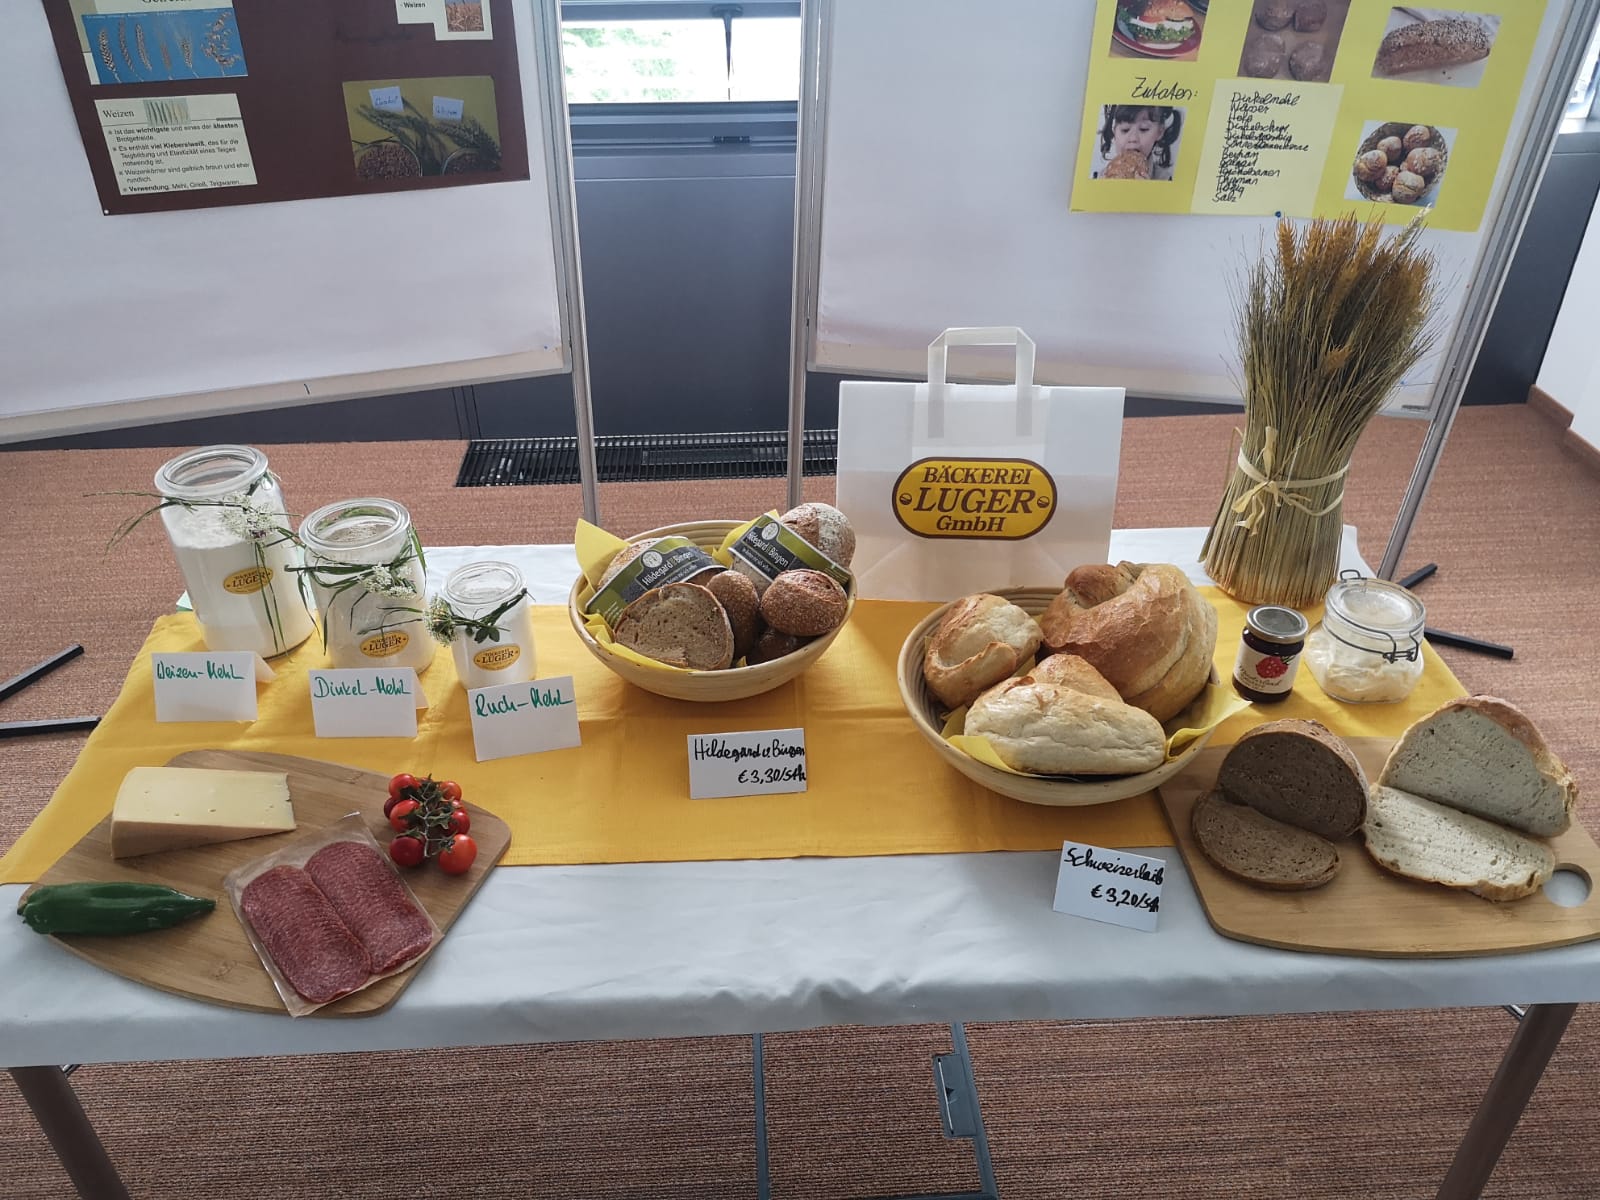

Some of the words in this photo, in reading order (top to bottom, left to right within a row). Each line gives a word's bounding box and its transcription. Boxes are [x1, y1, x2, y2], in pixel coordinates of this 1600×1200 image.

[1132, 77, 1198, 100] Zutaten:
[103, 110, 134, 118] Weizen
[922, 465, 1033, 485] BÄCKEREI
[912, 487, 1036, 514] LUGER
[936, 515, 1007, 532] GmbH
[768, 546, 789, 568] Bingen
[642, 562, 673, 586] Hildegard
[370, 637, 402, 650] LUGER
[482, 650, 514, 664] LUGER
[694, 738, 760, 762] Hildegard
[772, 738, 806, 758] Bingen
[1064, 847, 1164, 886] Schweizerlaib
